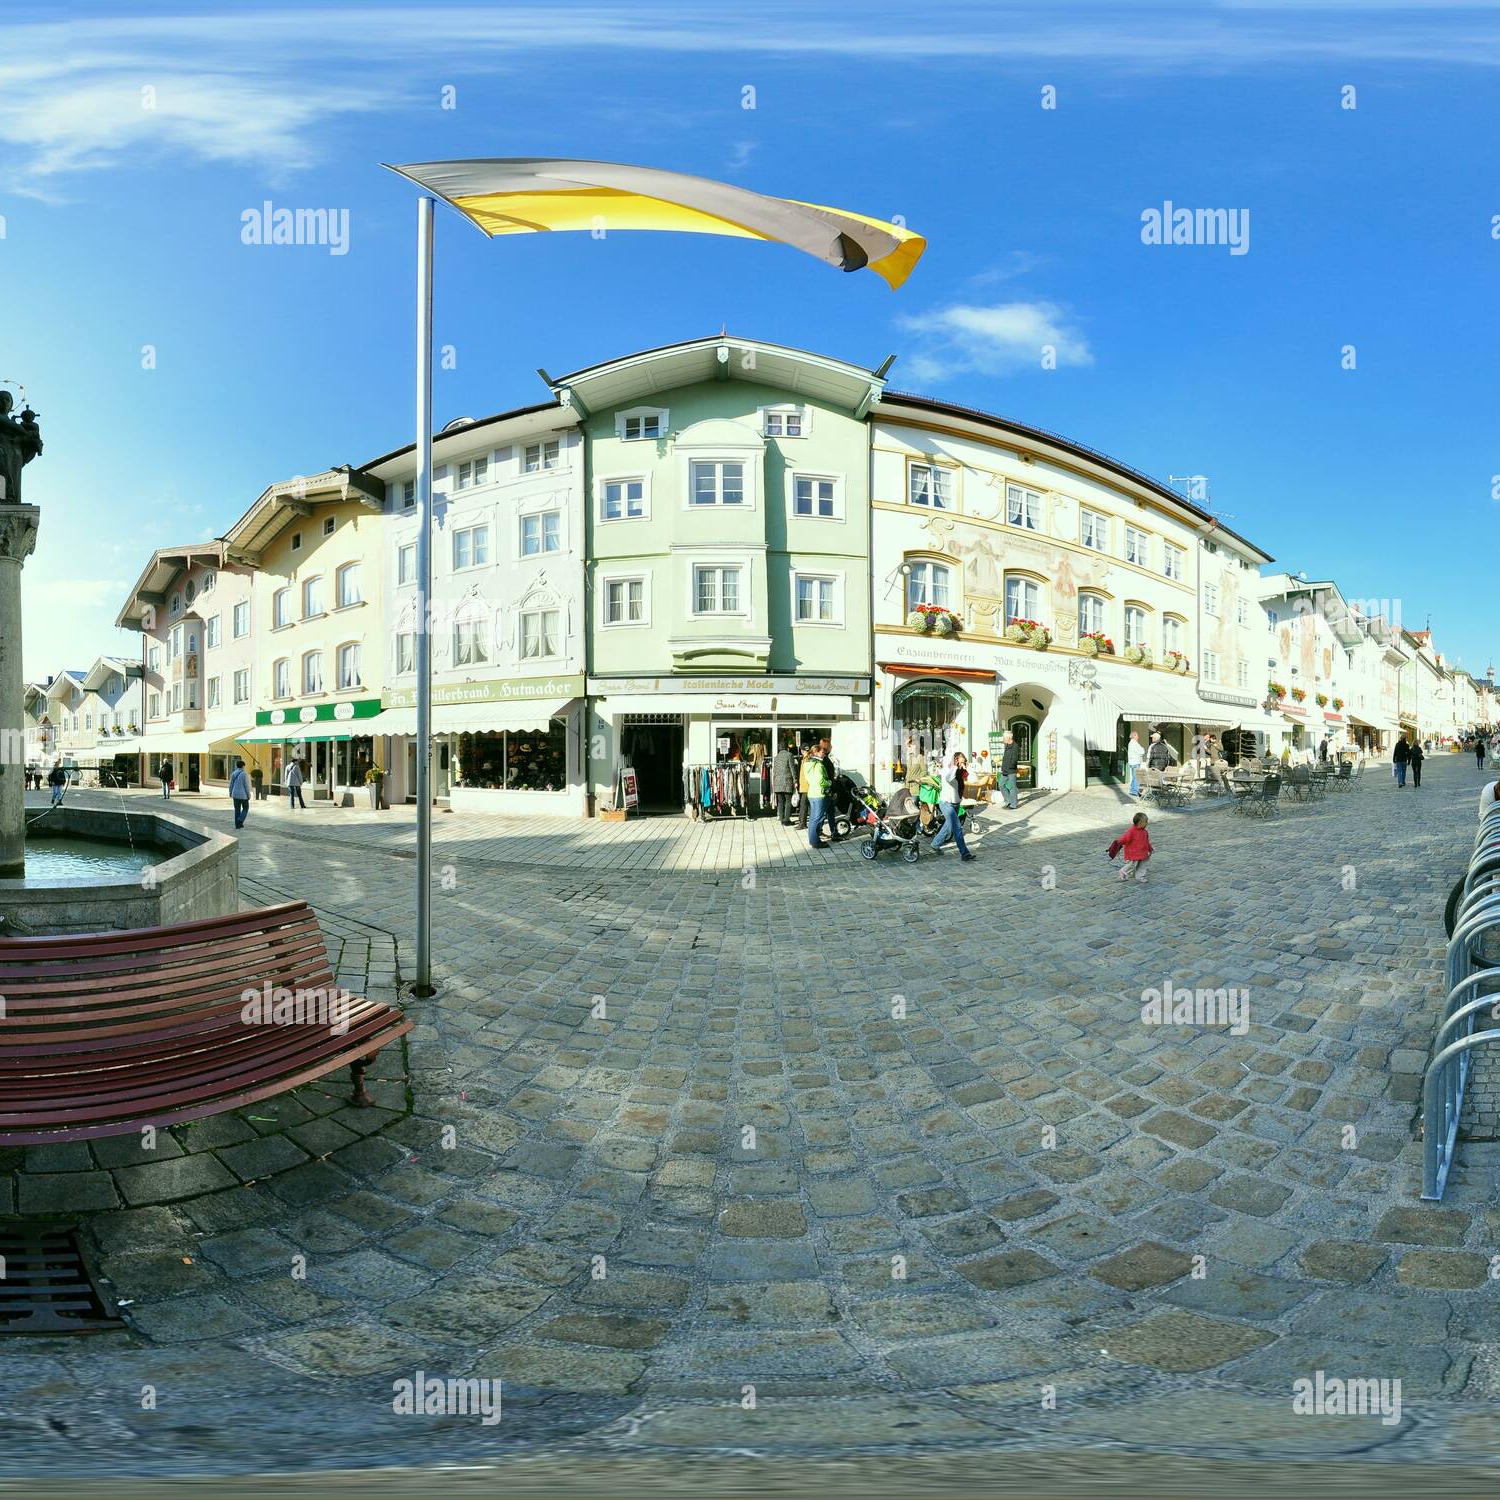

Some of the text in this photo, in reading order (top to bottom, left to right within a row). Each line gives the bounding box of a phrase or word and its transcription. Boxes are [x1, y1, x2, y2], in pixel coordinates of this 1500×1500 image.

[431, 684, 490, 702] illerbrand
[500, 680, 572, 697] Hutmacher
[682, 679, 774, 689] Italienische Mode
